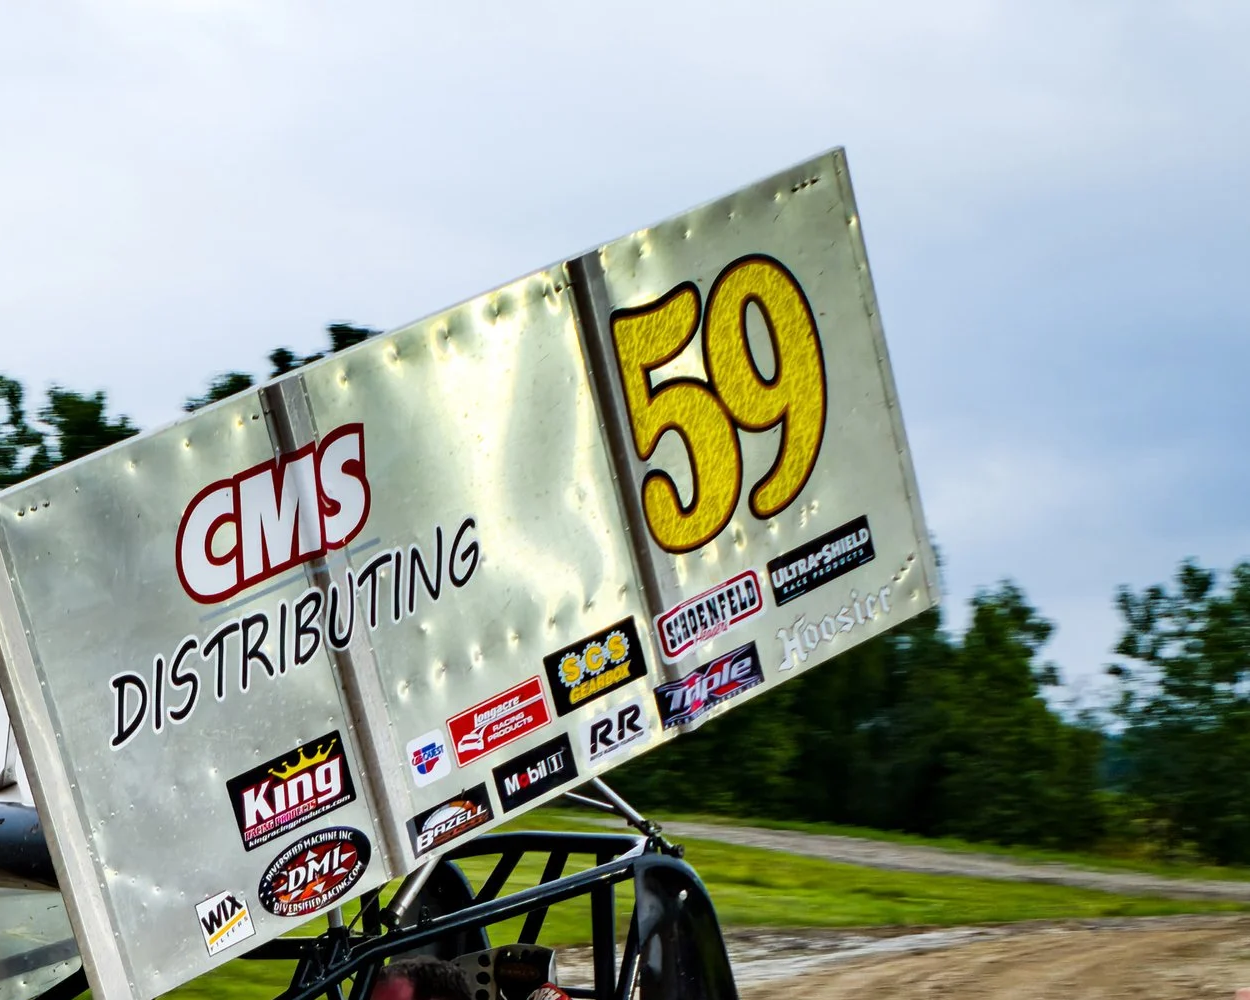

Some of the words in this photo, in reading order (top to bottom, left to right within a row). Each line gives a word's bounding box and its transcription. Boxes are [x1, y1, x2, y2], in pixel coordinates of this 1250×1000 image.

[610, 253, 827, 554] 59
[175, 423, 371, 604] CMS
[110, 515, 481, 751] DISTRIBUTING
[776, 585, 892, 672] Hoosier
[560, 634, 628, 684] SCS
[569, 660, 631, 704] GEARBOX
[474, 695, 520, 728] Longacre
[487, 716, 533, 742] PRODUCTS
[492, 711, 524, 732] RACING
[243, 757, 342, 829] King
[504, 761, 547, 796] Mobil
[249, 795, 350, 847] kingracingproducts.com
[417, 804, 487, 852] BAZELL
[265, 843, 304, 882] DIVERSIFIED
[303, 831, 336, 850] MACHINE
[339, 830, 353, 841] INC
[287, 842, 342, 892] DMI
[201, 895, 243, 936] WIX
